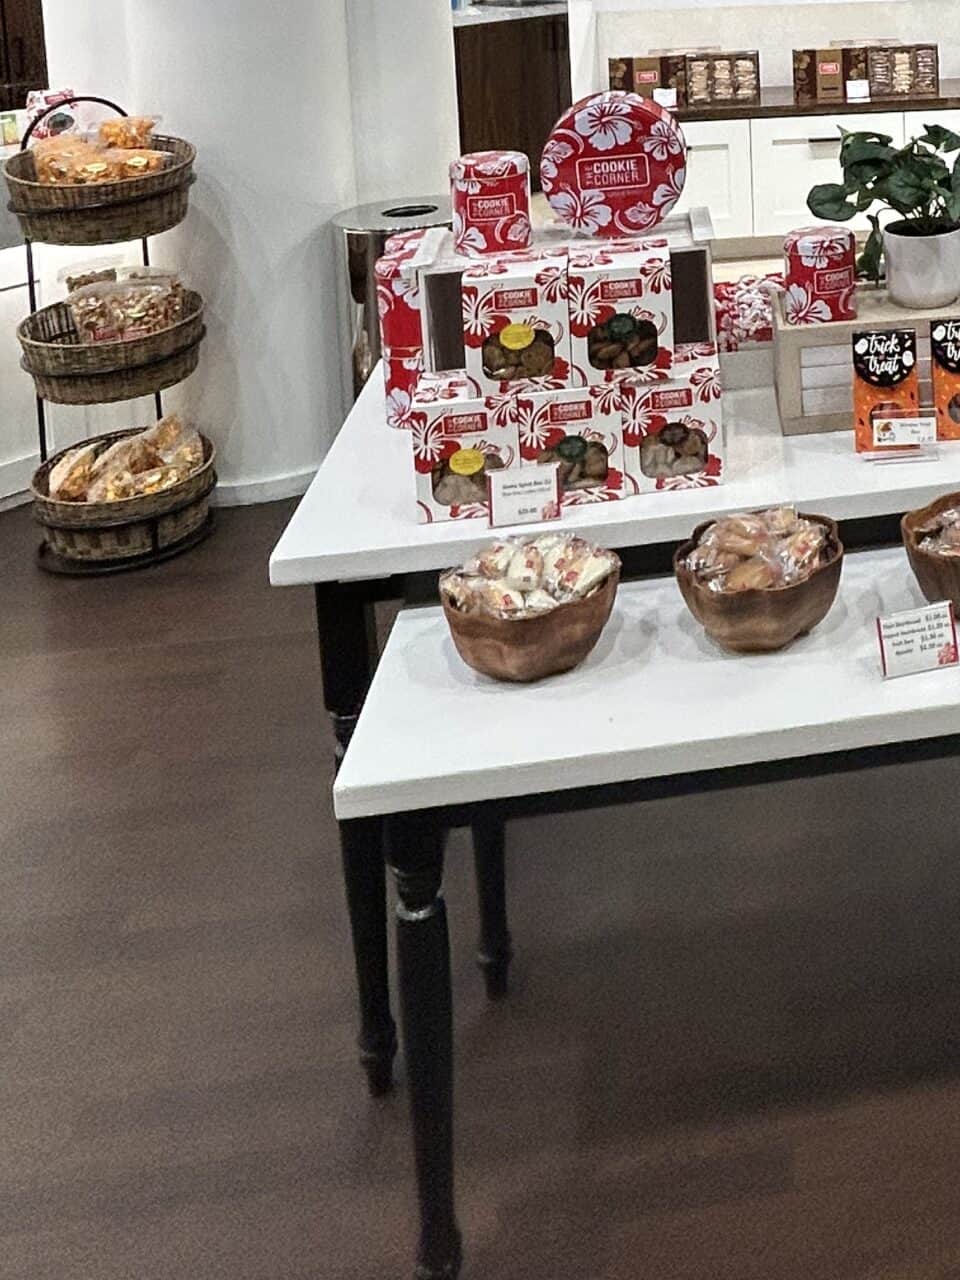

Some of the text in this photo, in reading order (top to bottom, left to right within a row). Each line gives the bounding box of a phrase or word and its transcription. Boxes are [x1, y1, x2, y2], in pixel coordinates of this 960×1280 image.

[593, 158, 638, 174] COOKIE
[593, 171, 640, 186] CORNER
[477, 197, 509, 210] COOKIE
[866, 333, 901, 355] trick
[864, 355, 902, 375] treat
